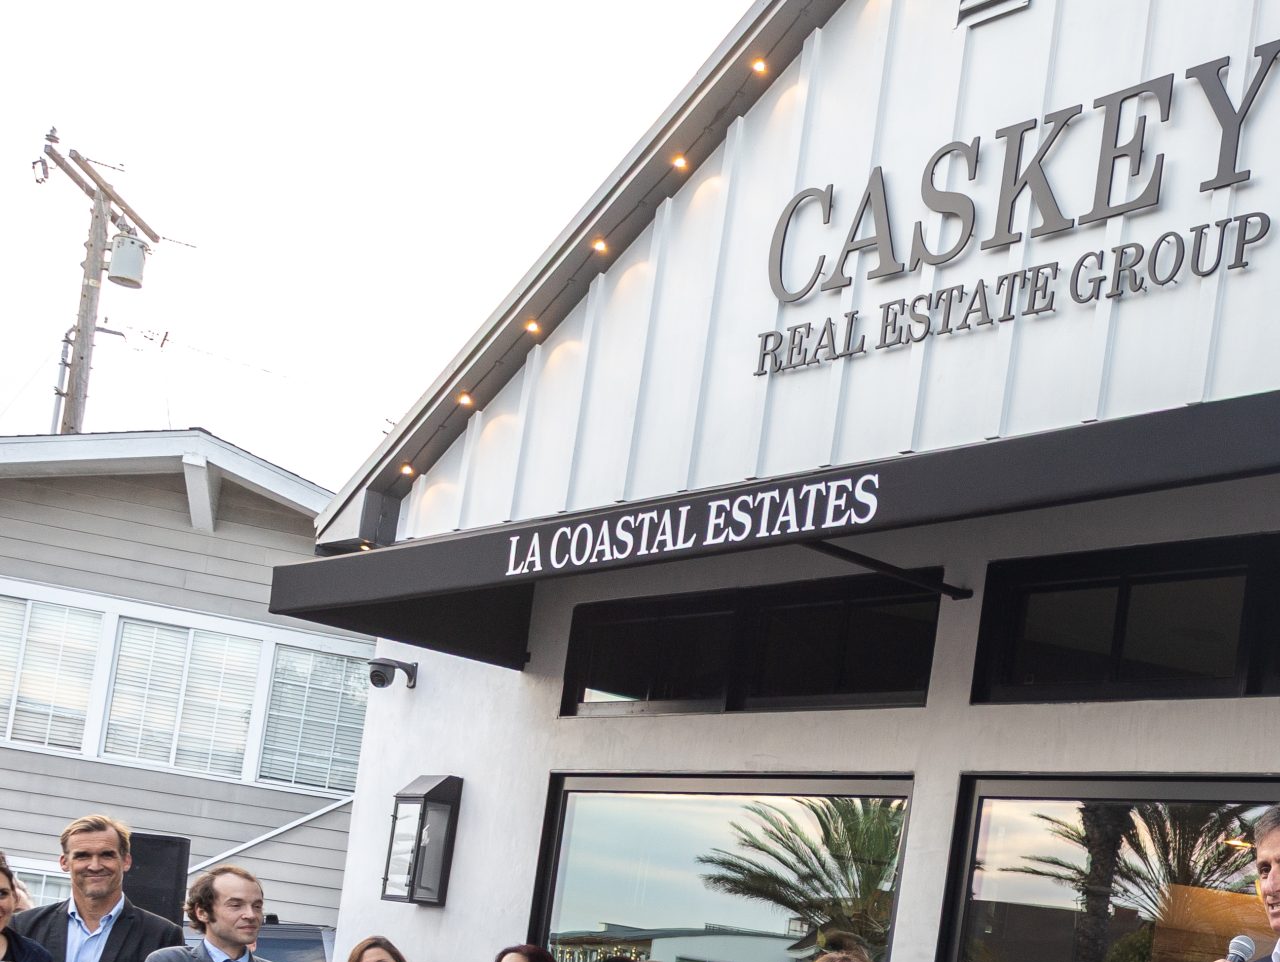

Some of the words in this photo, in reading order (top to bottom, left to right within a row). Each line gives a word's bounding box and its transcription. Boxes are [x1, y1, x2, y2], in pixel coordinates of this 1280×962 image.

[753, 309, 867, 377] REAL
[875, 262, 1060, 350] ESTATE
[1069, 211, 1271, 304] GROUP
[505, 532, 543, 576] LA
[549, 505, 697, 568] COASTAL
[702, 474, 880, 546] ESTATES
